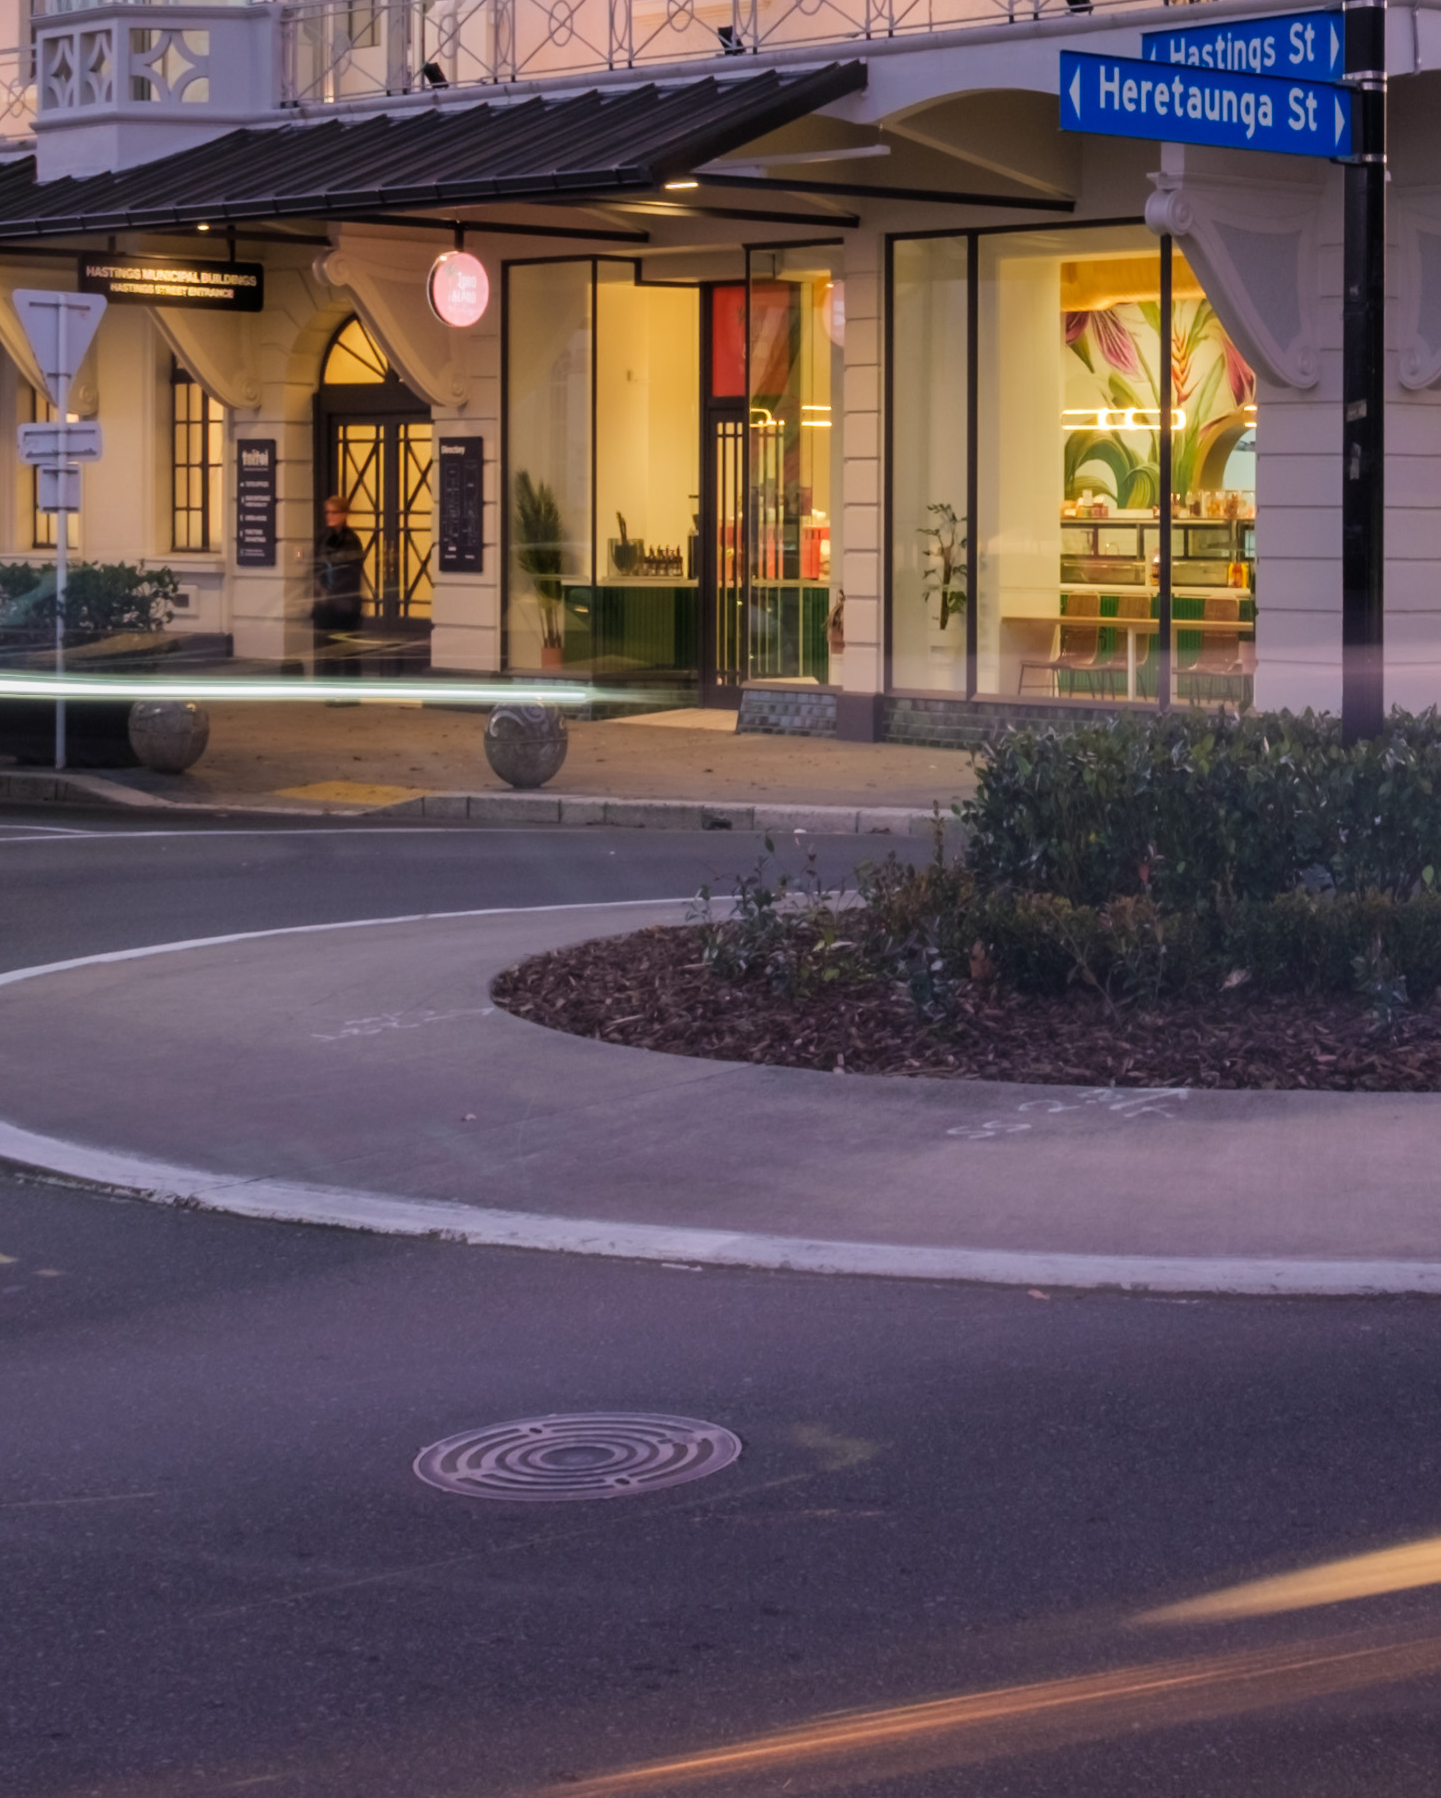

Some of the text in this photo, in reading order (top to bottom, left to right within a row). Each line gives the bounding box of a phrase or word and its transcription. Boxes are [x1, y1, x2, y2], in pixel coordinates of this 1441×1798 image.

[1170, 22, 1316, 74] Hastings St
[1100, 65, 1318, 140] Heretaunga St
[86, 266, 257, 287] HASTINGS MUNICIPAL BUILDINGS
[110, 282, 154, 295] HASTINGS
[155, 284, 187, 297] STREET
